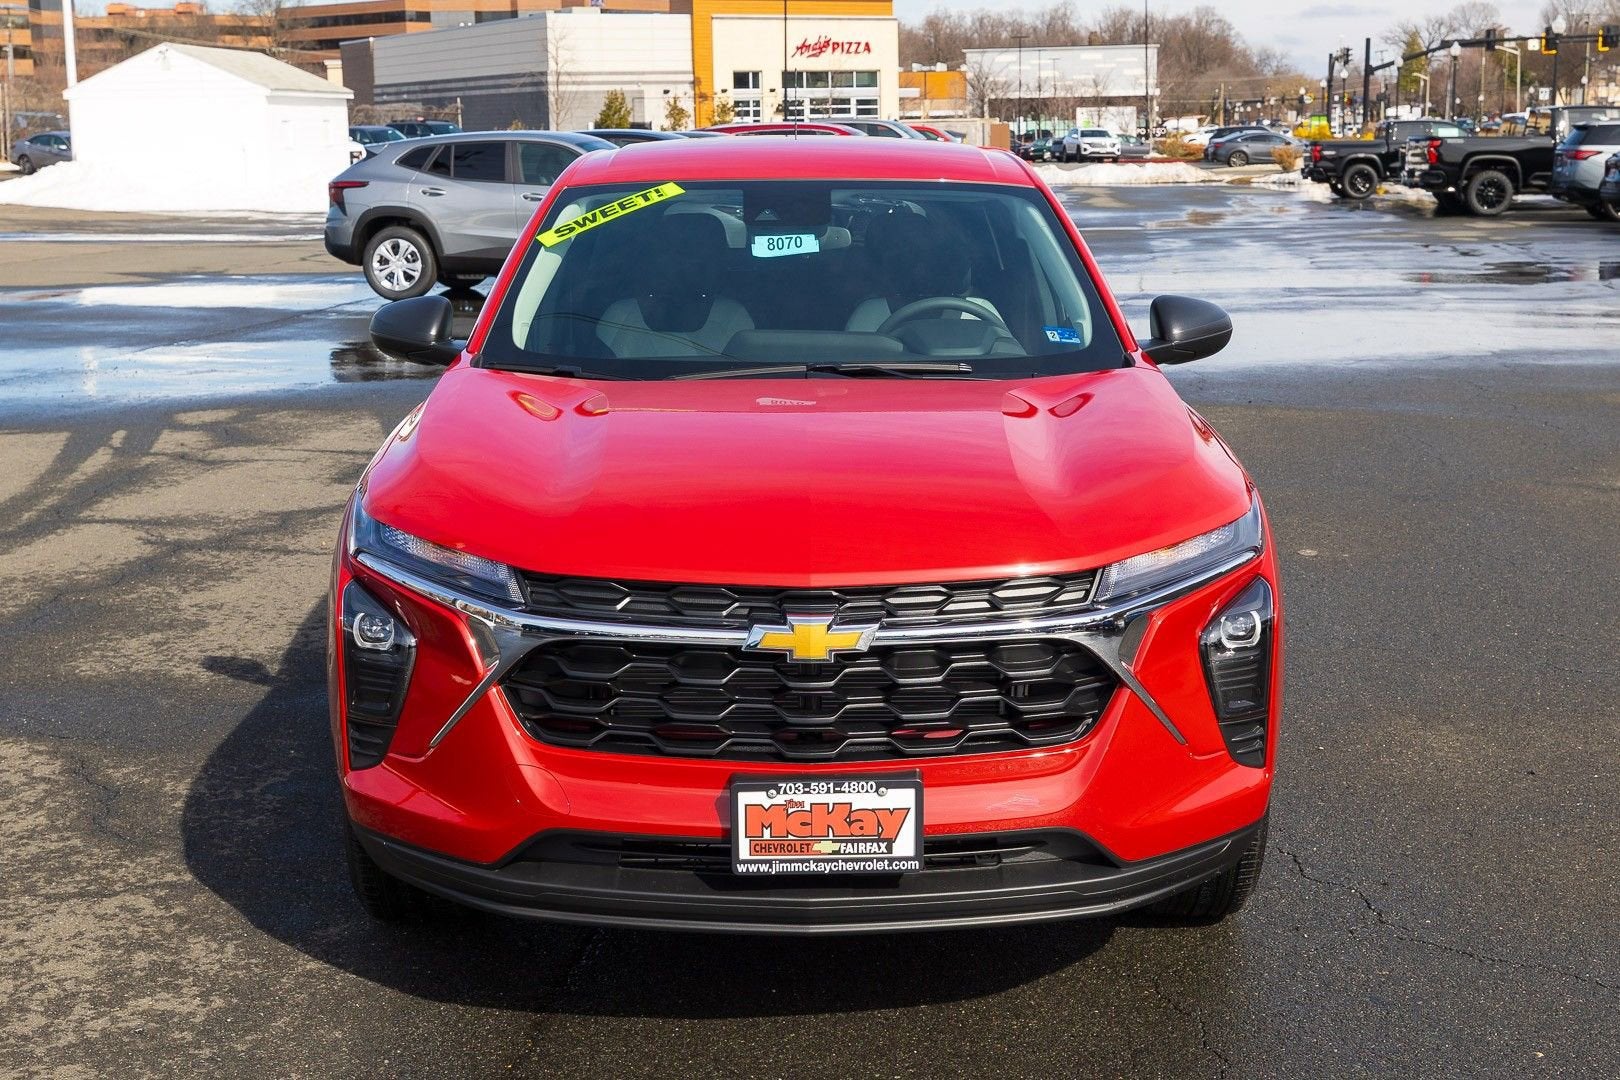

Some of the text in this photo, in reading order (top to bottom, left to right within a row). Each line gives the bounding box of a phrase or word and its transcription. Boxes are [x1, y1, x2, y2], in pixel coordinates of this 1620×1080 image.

[832, 41, 871, 55] PIZZA
[553, 187, 664, 238] SWEET!
[767, 236, 803, 251] 8070
[777, 781, 877, 795] 703-591-4800
[744, 802, 911, 843] McKay
[753, 842, 888, 854] CHEVROLET FAIRFAX
[736, 859, 919, 874] www.jimmckaychevrolet.com
